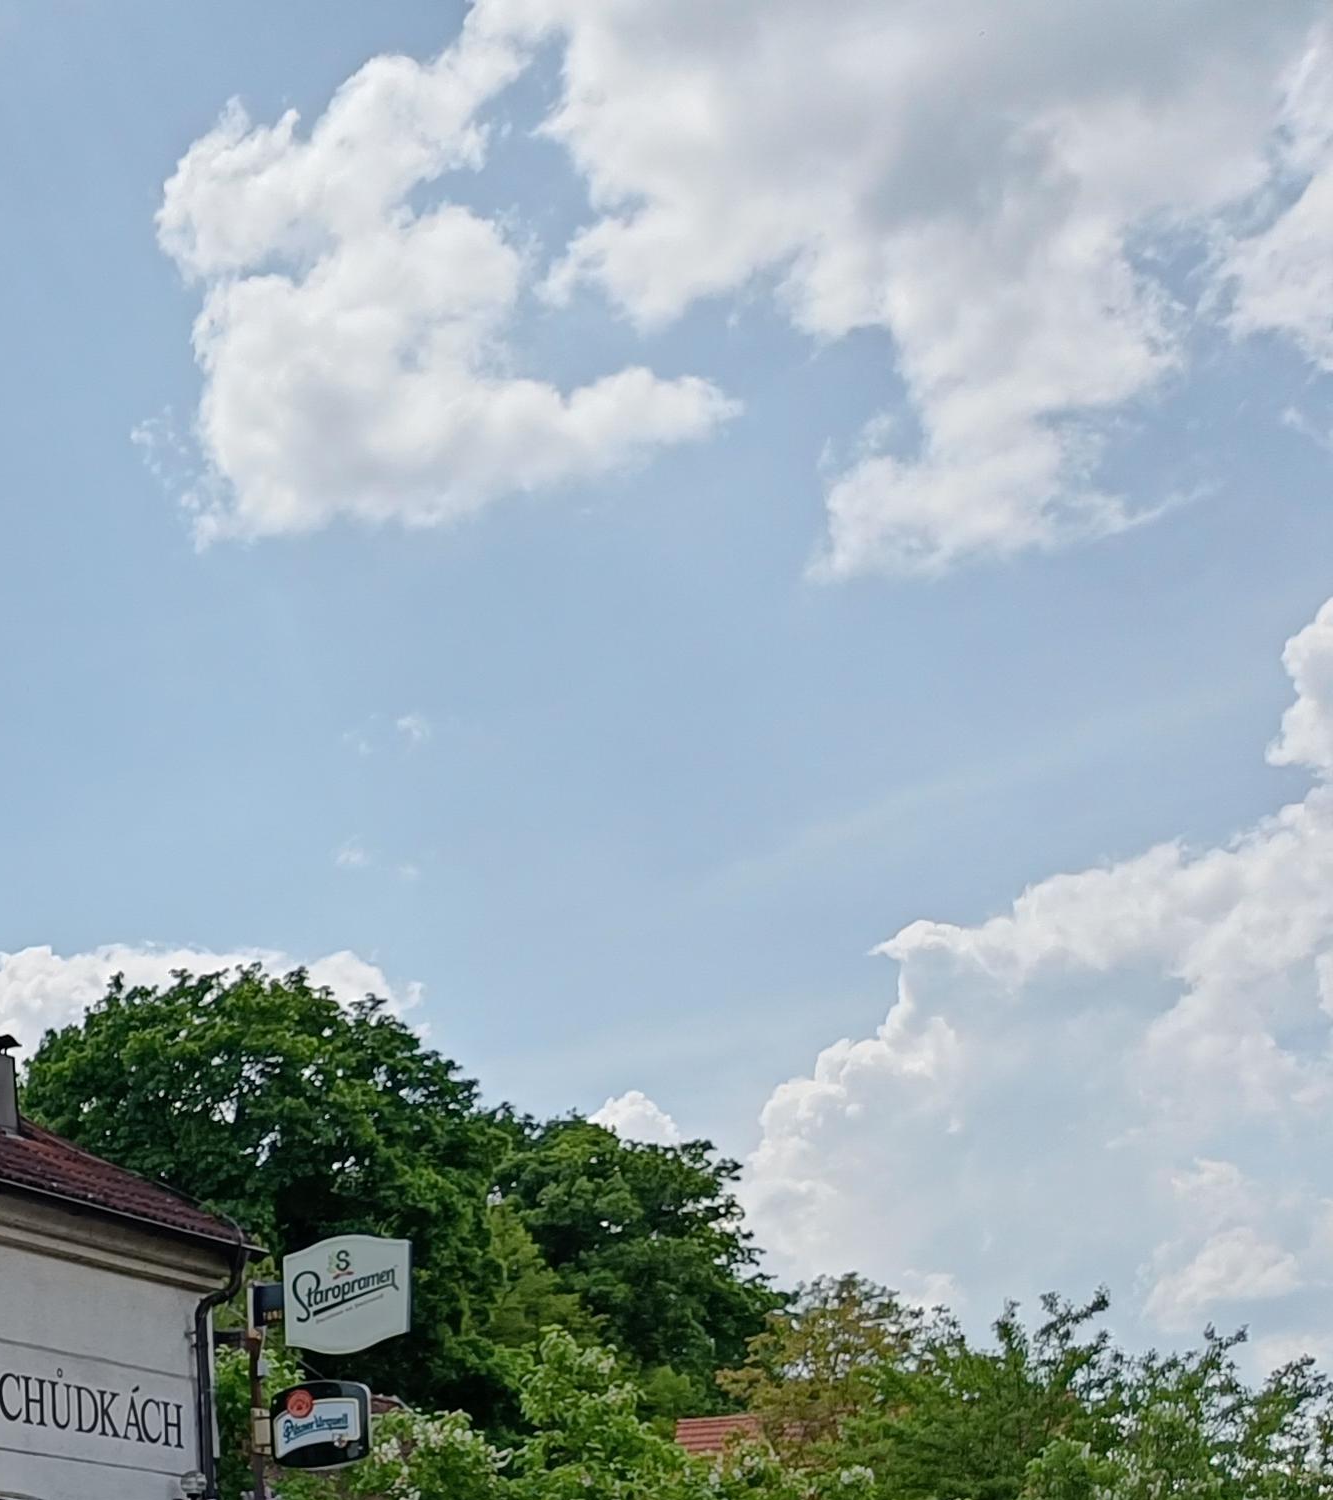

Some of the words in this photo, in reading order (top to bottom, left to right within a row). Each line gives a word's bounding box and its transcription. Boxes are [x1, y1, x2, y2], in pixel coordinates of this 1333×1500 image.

[336, 1249, 350, 1271] S
[293, 1267, 399, 1322] Staropramen
[283, 1418, 314, 1444] Pilsner
[314, 1413, 348, 1431] Urquell
